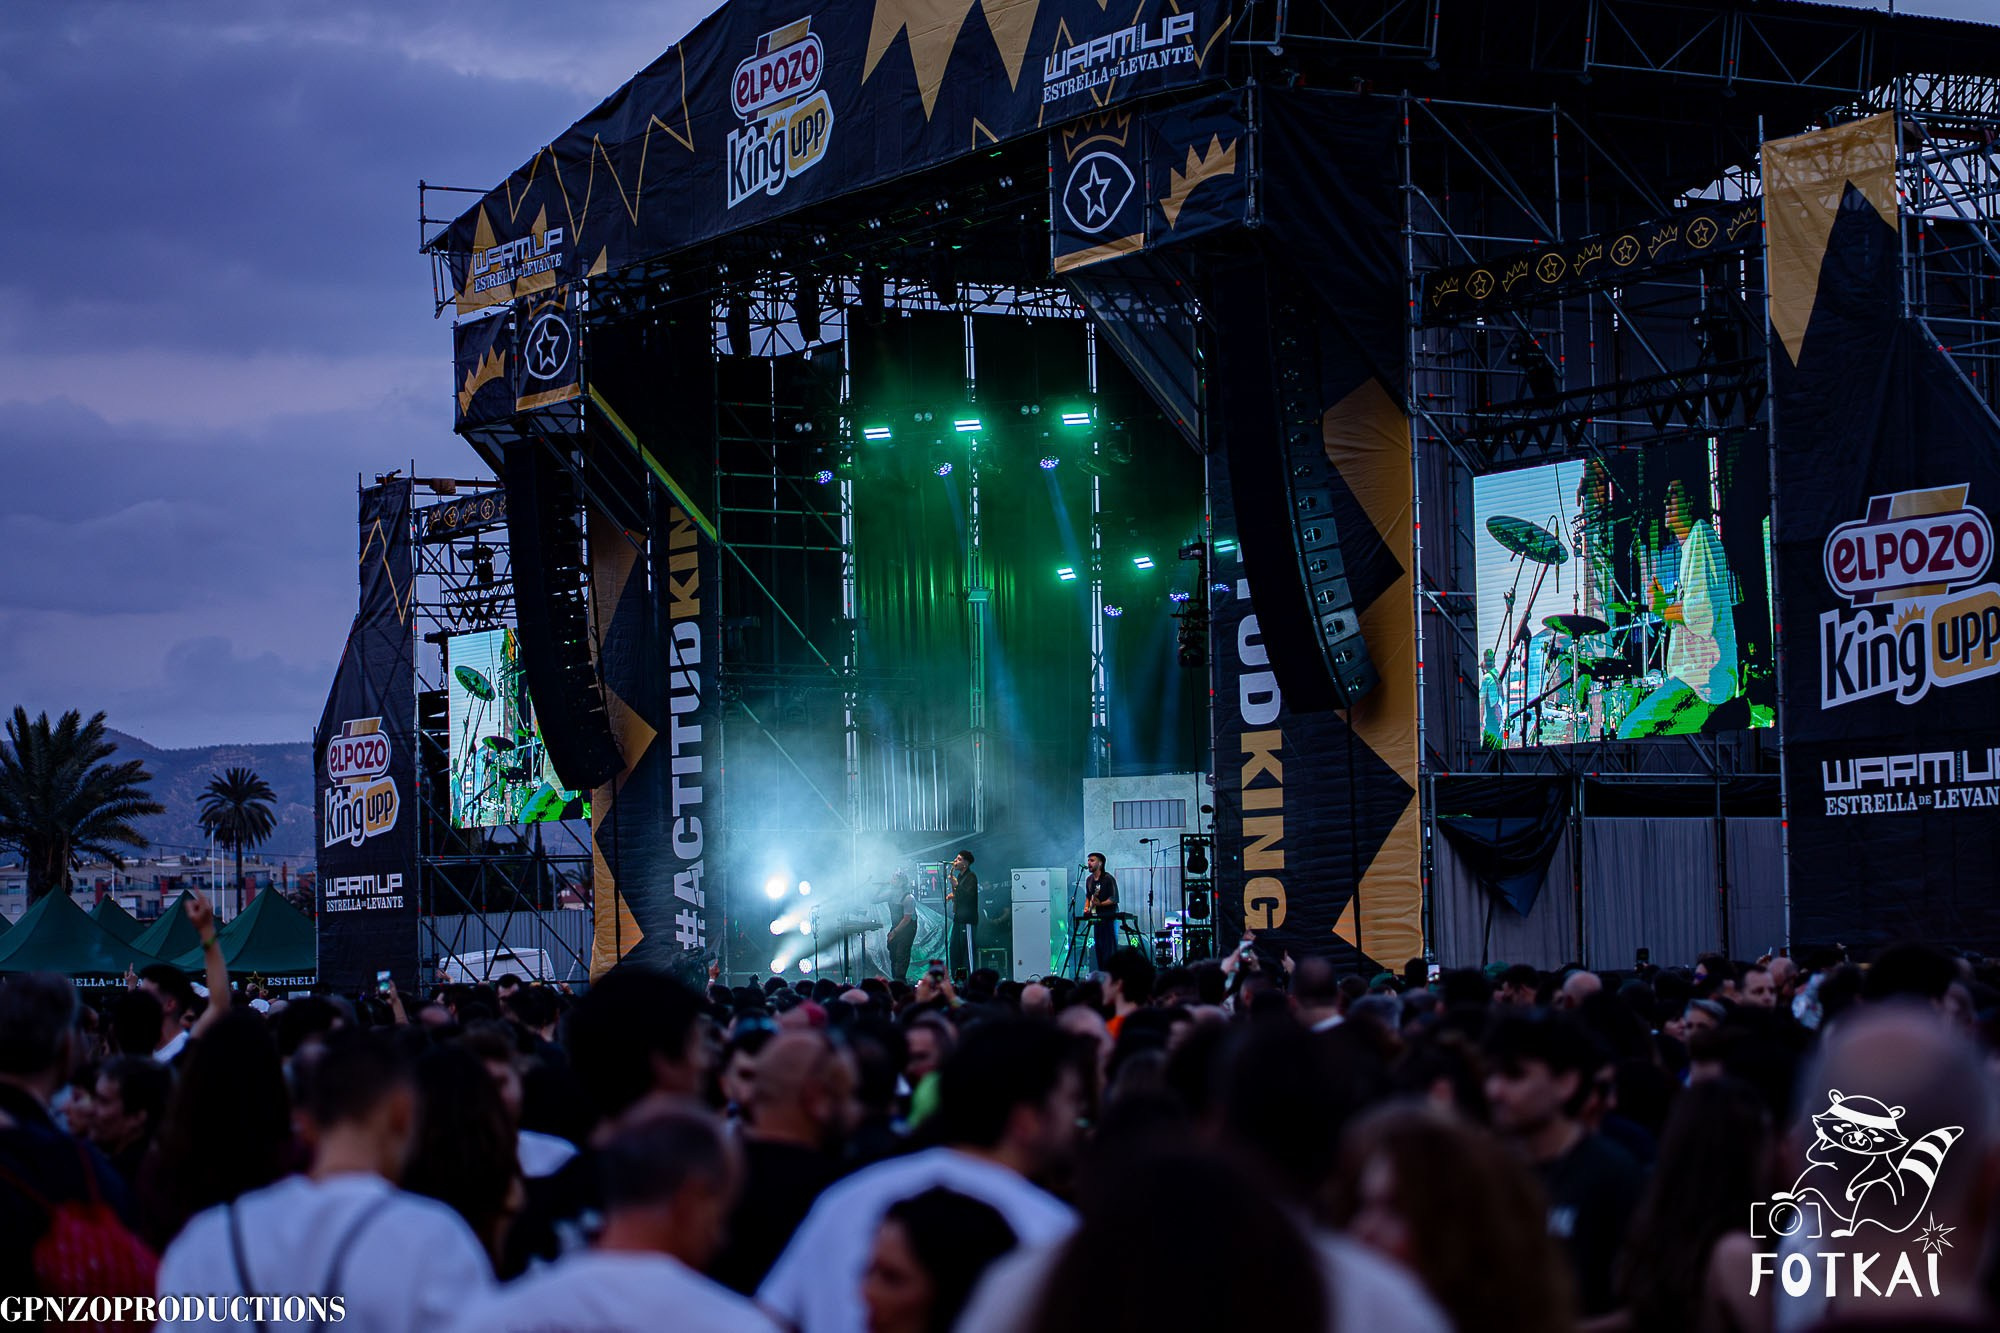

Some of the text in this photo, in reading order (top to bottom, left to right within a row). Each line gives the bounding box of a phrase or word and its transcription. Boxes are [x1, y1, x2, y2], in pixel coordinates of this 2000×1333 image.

[1043, 11, 1194, 83] WARM UP
[1043, 44, 1194, 104] ESTRELLA DE LEVANTE
[473, 235, 531, 276] WARM
[532, 227, 563, 257] UP
[474, 266, 516, 293] ESTRELLA
[521, 252, 562, 278] LEVANTE
[669, 505, 706, 950] #ACTITUDKIN
[1822, 751, 1956, 792] WARM
[1824, 785, 2000, 816] ESTRELLA DE LEVAN
[325, 874, 375, 898] WARM
[377, 873, 403, 894] UP
[326, 898, 361, 913] ESTRELLA
[366, 895, 404, 910] LEVANTE
